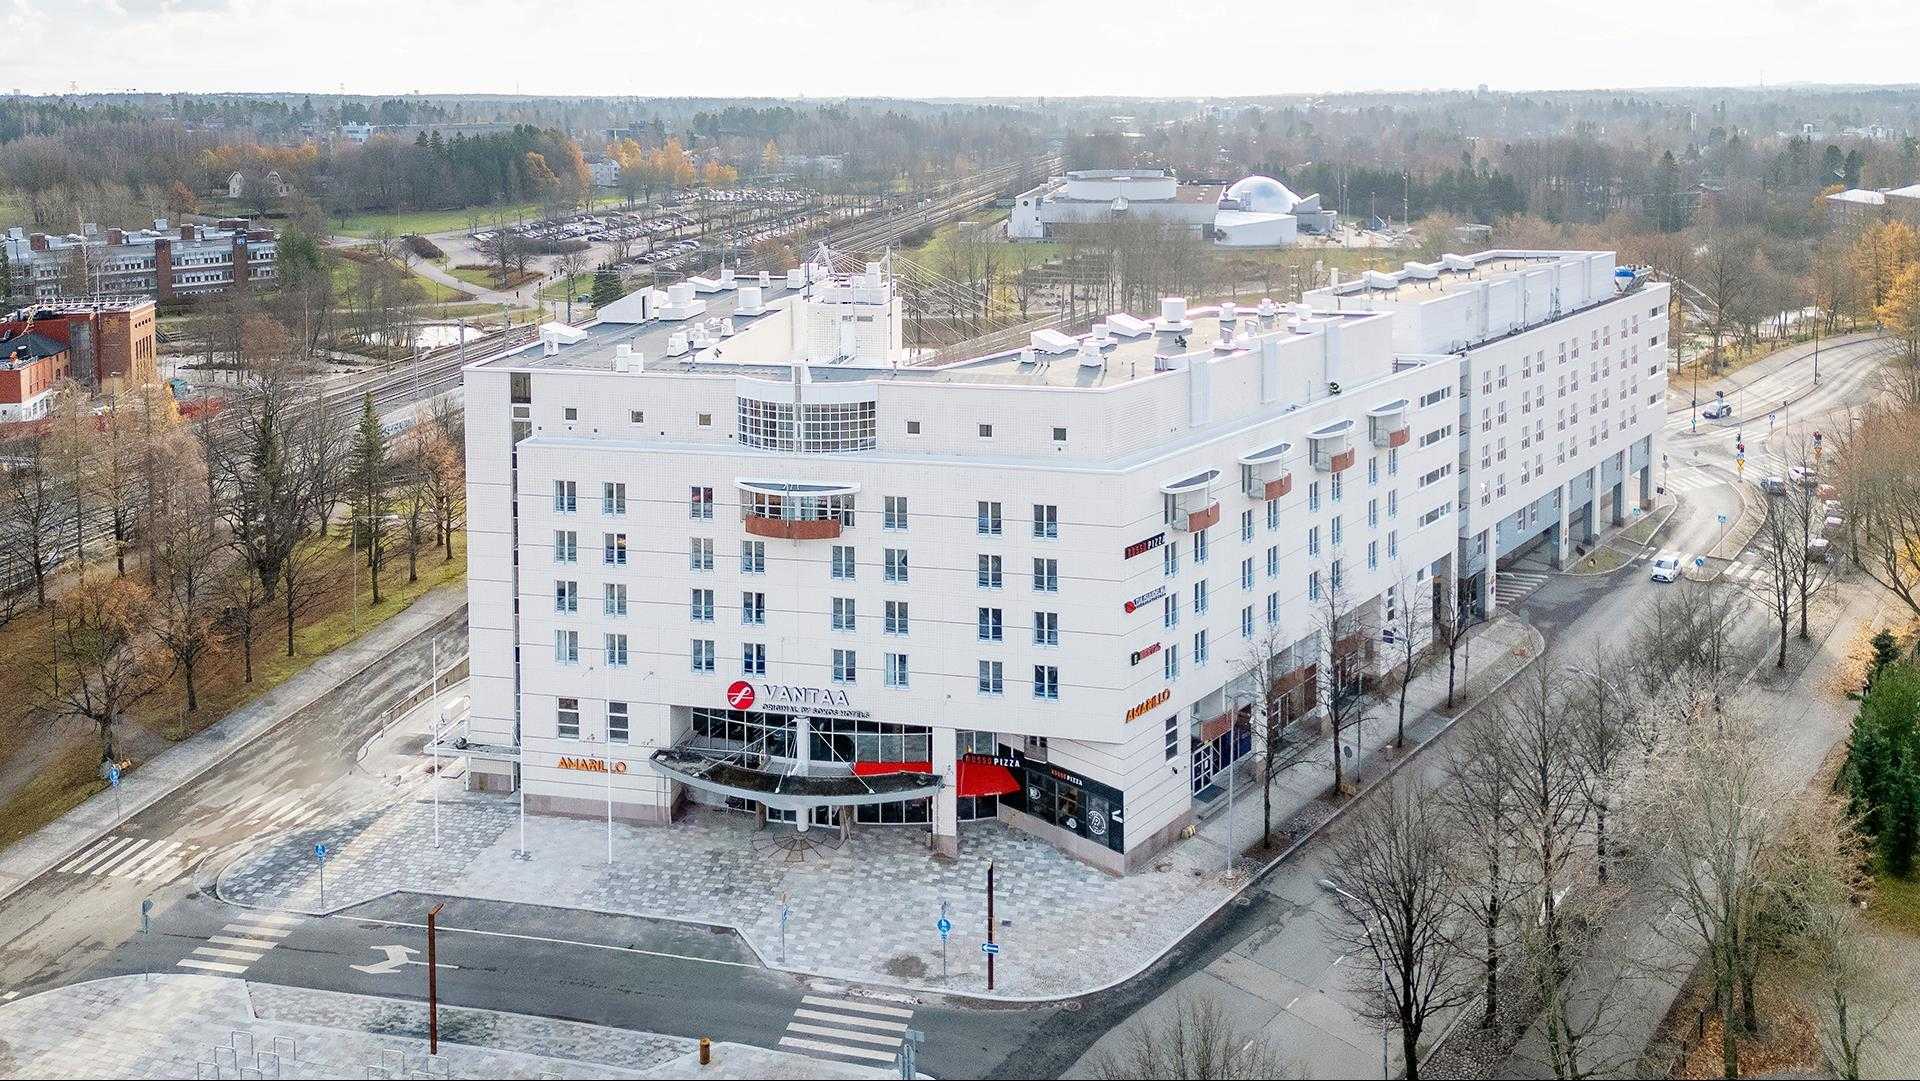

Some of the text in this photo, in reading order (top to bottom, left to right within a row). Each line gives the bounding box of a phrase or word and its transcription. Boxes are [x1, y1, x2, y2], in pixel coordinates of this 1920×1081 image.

[763, 684, 850, 706] VANTAA
[1125, 688, 1171, 724] AMARILLO
[556, 756, 627, 775] AMARILLO
